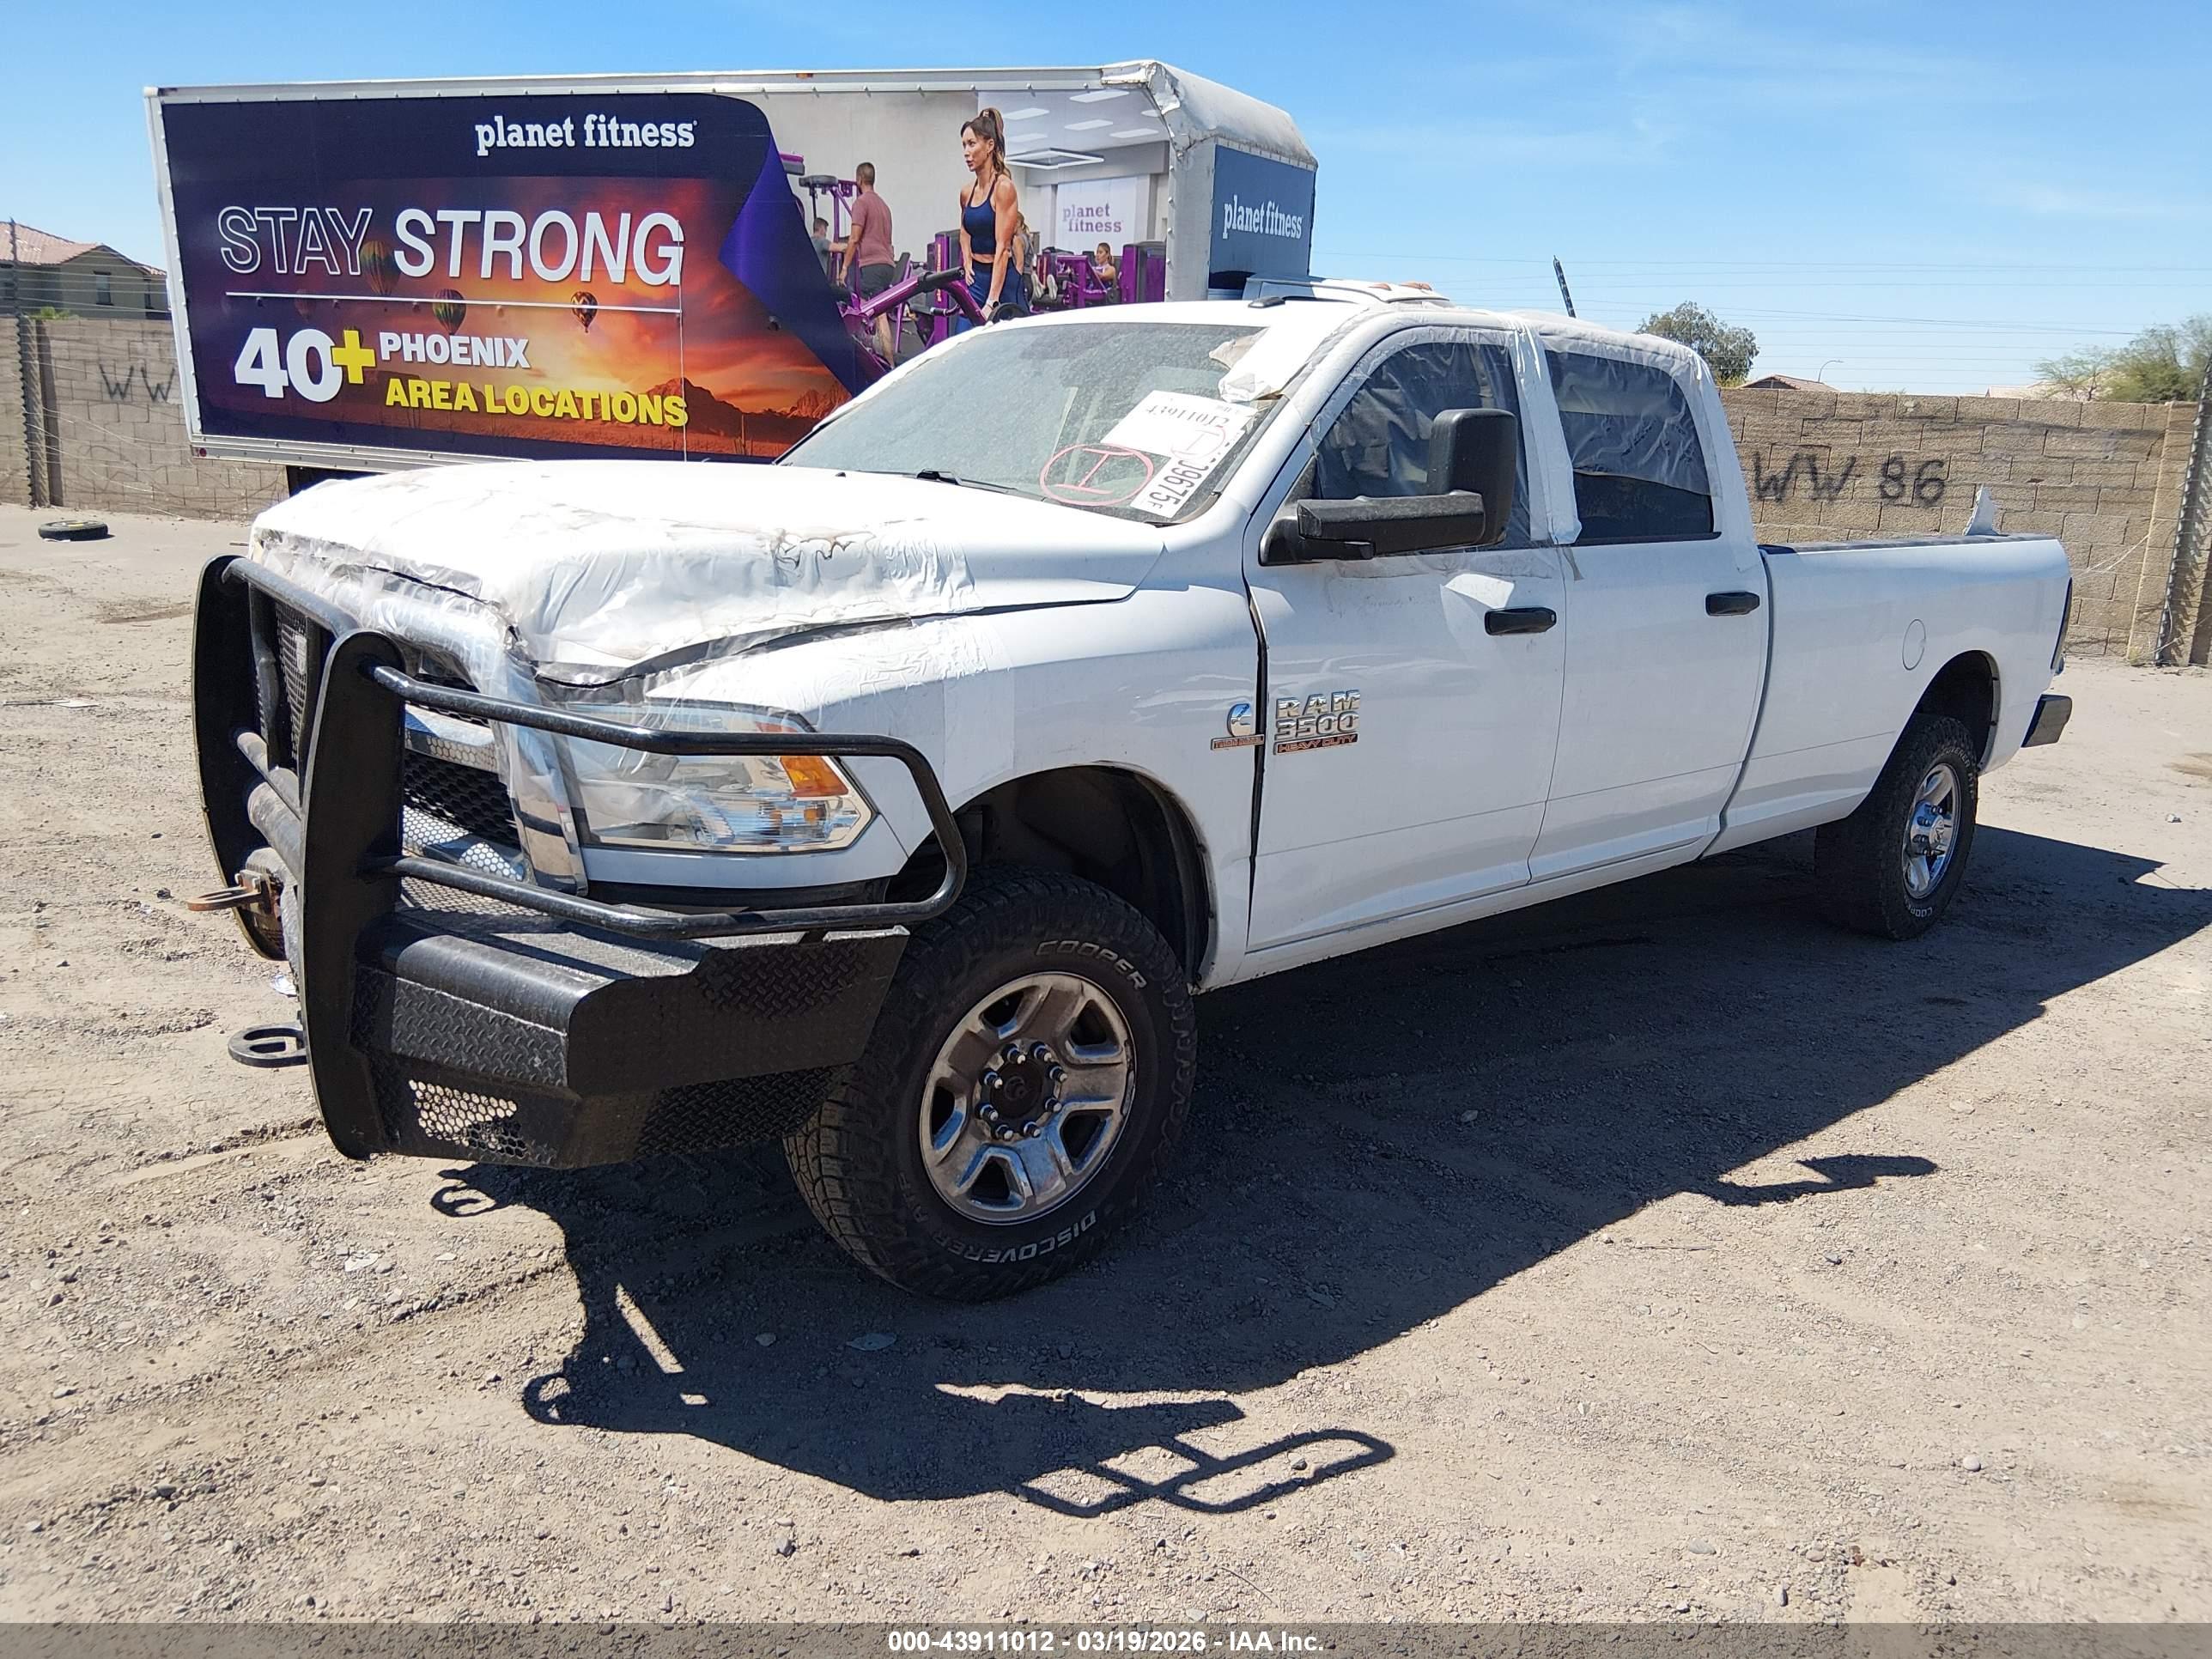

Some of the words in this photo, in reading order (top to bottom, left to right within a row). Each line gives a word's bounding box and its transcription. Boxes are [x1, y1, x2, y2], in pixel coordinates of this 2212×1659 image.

[475, 115, 575, 156] planet
[584, 114, 695, 148] fitness
[1062, 203, 1110, 221] planet
[1068, 219, 1121, 233] fitness
[1223, 194, 1265, 240] planet
[1266, 200, 1303, 239] fitness
[217, 205, 374, 276] STAY
[394, 208, 684, 286] STRONG
[380, 331, 531, 369] PHOENIX
[386, 378, 483, 413] AREA
[485, 384, 689, 427] LOCATIONS
[1879, 454, 1946, 506] 86
[1274, 711, 1360, 740] 3500
[1276, 690, 1360, 719] RAM
[1279, 739, 1321, 753] HEAVY
[1322, 734, 1357, 747] DUTY
[1036, 939, 1147, 989] COOPER
[933, 1209, 1097, 1263] DISCOVERER
